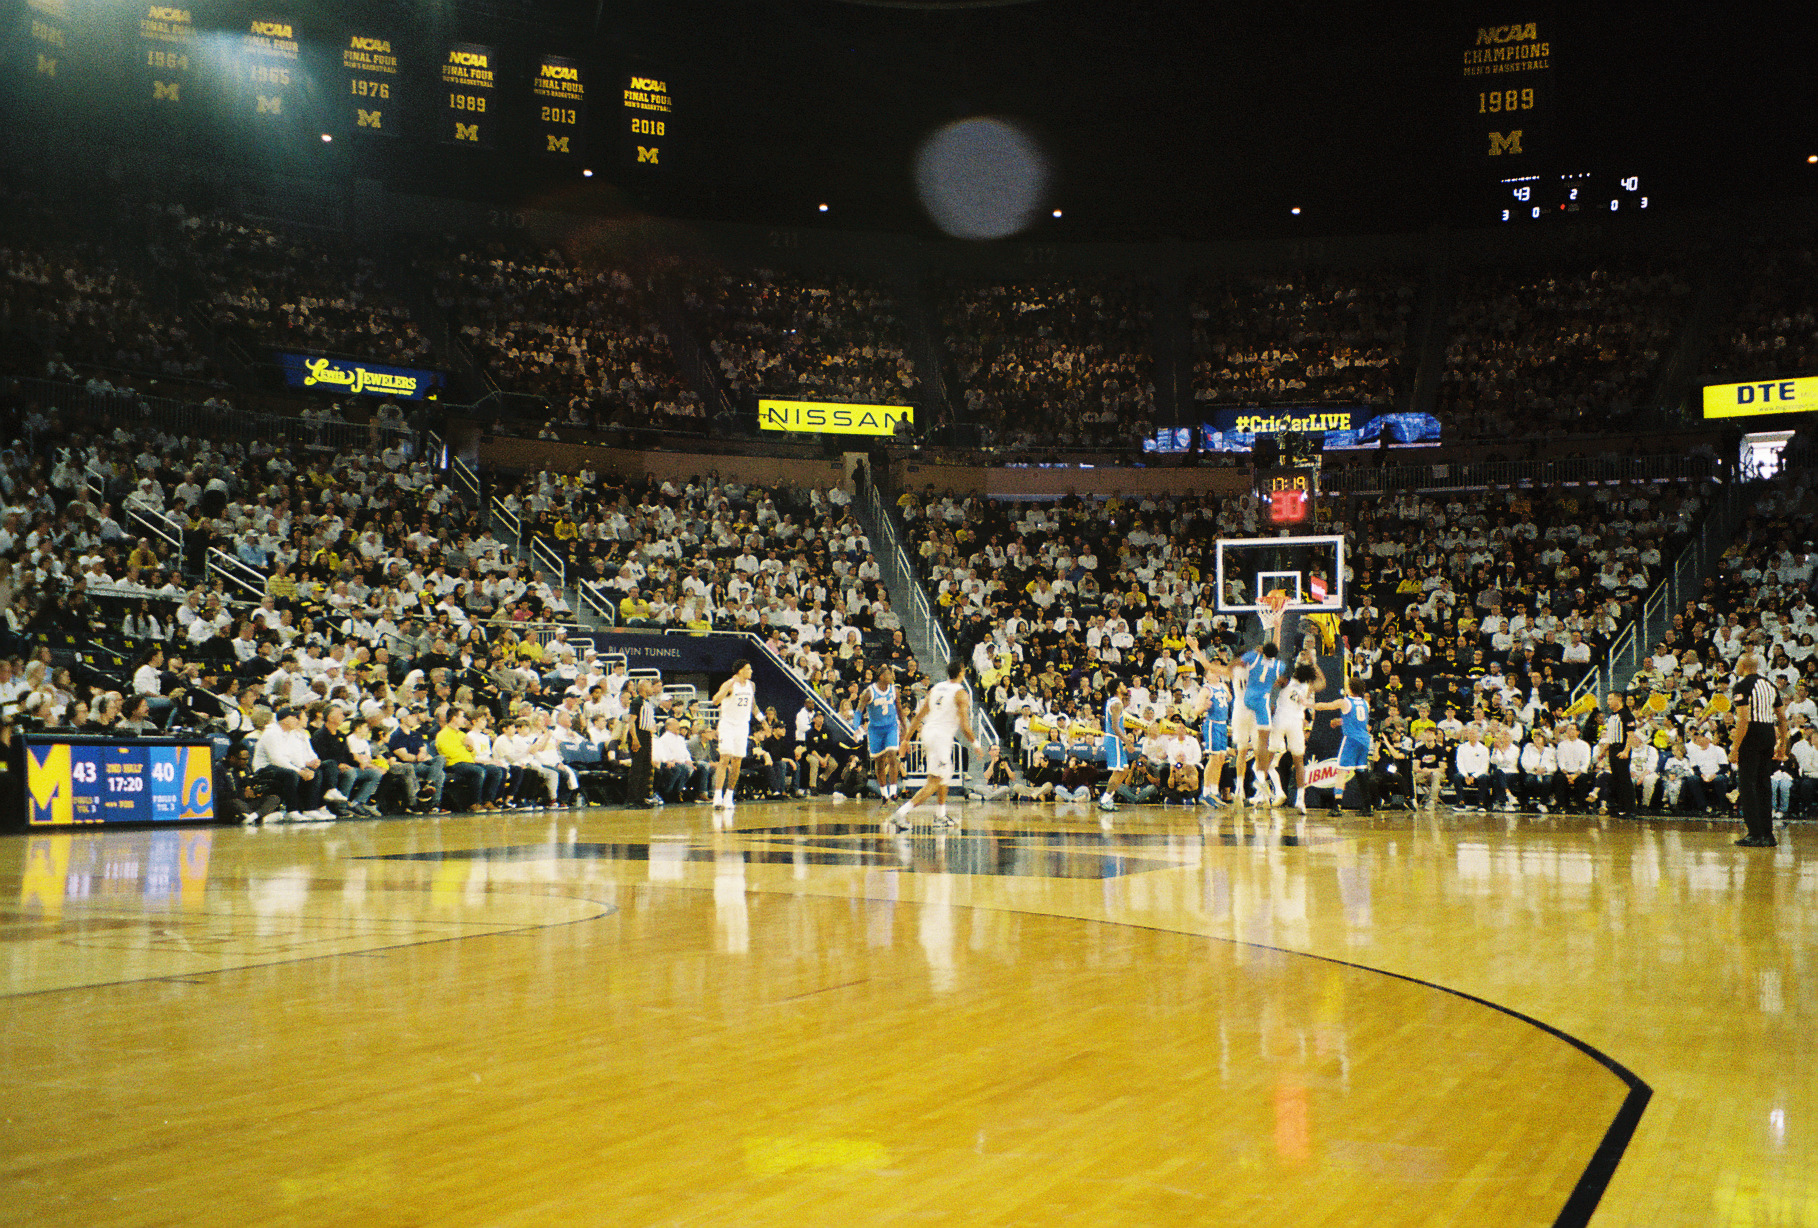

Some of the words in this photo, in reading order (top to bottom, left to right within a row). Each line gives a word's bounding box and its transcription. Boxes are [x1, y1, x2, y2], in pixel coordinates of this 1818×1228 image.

[148, 5, 191, 24] NCAA
[251, 21, 293, 38] NCAA
[1476, 22, 1537, 46] NCAA
[351, 36, 391, 53] NCAA
[343, 50, 372, 63] FINAL
[373, 54, 397, 65] FOUR
[449, 51, 488, 68] NCAA
[1463, 42, 1550, 65] CHAMPIONS
[442, 65, 469, 77] FINAL
[471, 69, 494, 81] FOUR
[540, 64, 578, 81] NCAA
[153, 81, 180, 101] M
[352, 79, 389, 99] 1976
[534, 78, 560, 90] FINAL
[562, 81, 584, 93] FOUR
[631, 76, 667, 93] NCAA
[256, 95, 282, 114] M
[449, 94, 486, 112] 1989
[624, 90, 649, 103] FINAL
[650, 94, 672, 105] FOUR
[1479, 88, 1534, 113] 1989
[357, 109, 382, 128] M
[541, 107, 576, 124] 2013
[455, 122, 479, 141] M
[631, 118, 665, 136] 2018
[547, 134, 570, 153] M
[1488, 129, 1523, 156] M
[637, 146, 659, 164] M
[1620, 176, 1638, 191] 40
[1513, 187, 1531, 201] 43
[1569, 188, 1578, 200] 2
[1610, 199, 1619, 211] 0
[1640, 197, 1648, 209] 3
[1501, 209, 1510, 221] 3
[1532, 206, 1540, 218] 0
[1737, 382, 1795, 405] DTE
[768, 407, 900, 429] NISSAN
[1272, 476, 1305, 491] 17:19
[1271, 491, 1305, 520] 30
[644, 647, 681, 658] TUNNEL
[737, 697, 749, 707] 23
[1355, 706, 1366, 722] 0
[73, 761, 97, 783] 43
[151, 762, 175, 782] 40
[107, 776, 144, 792] 17:20
